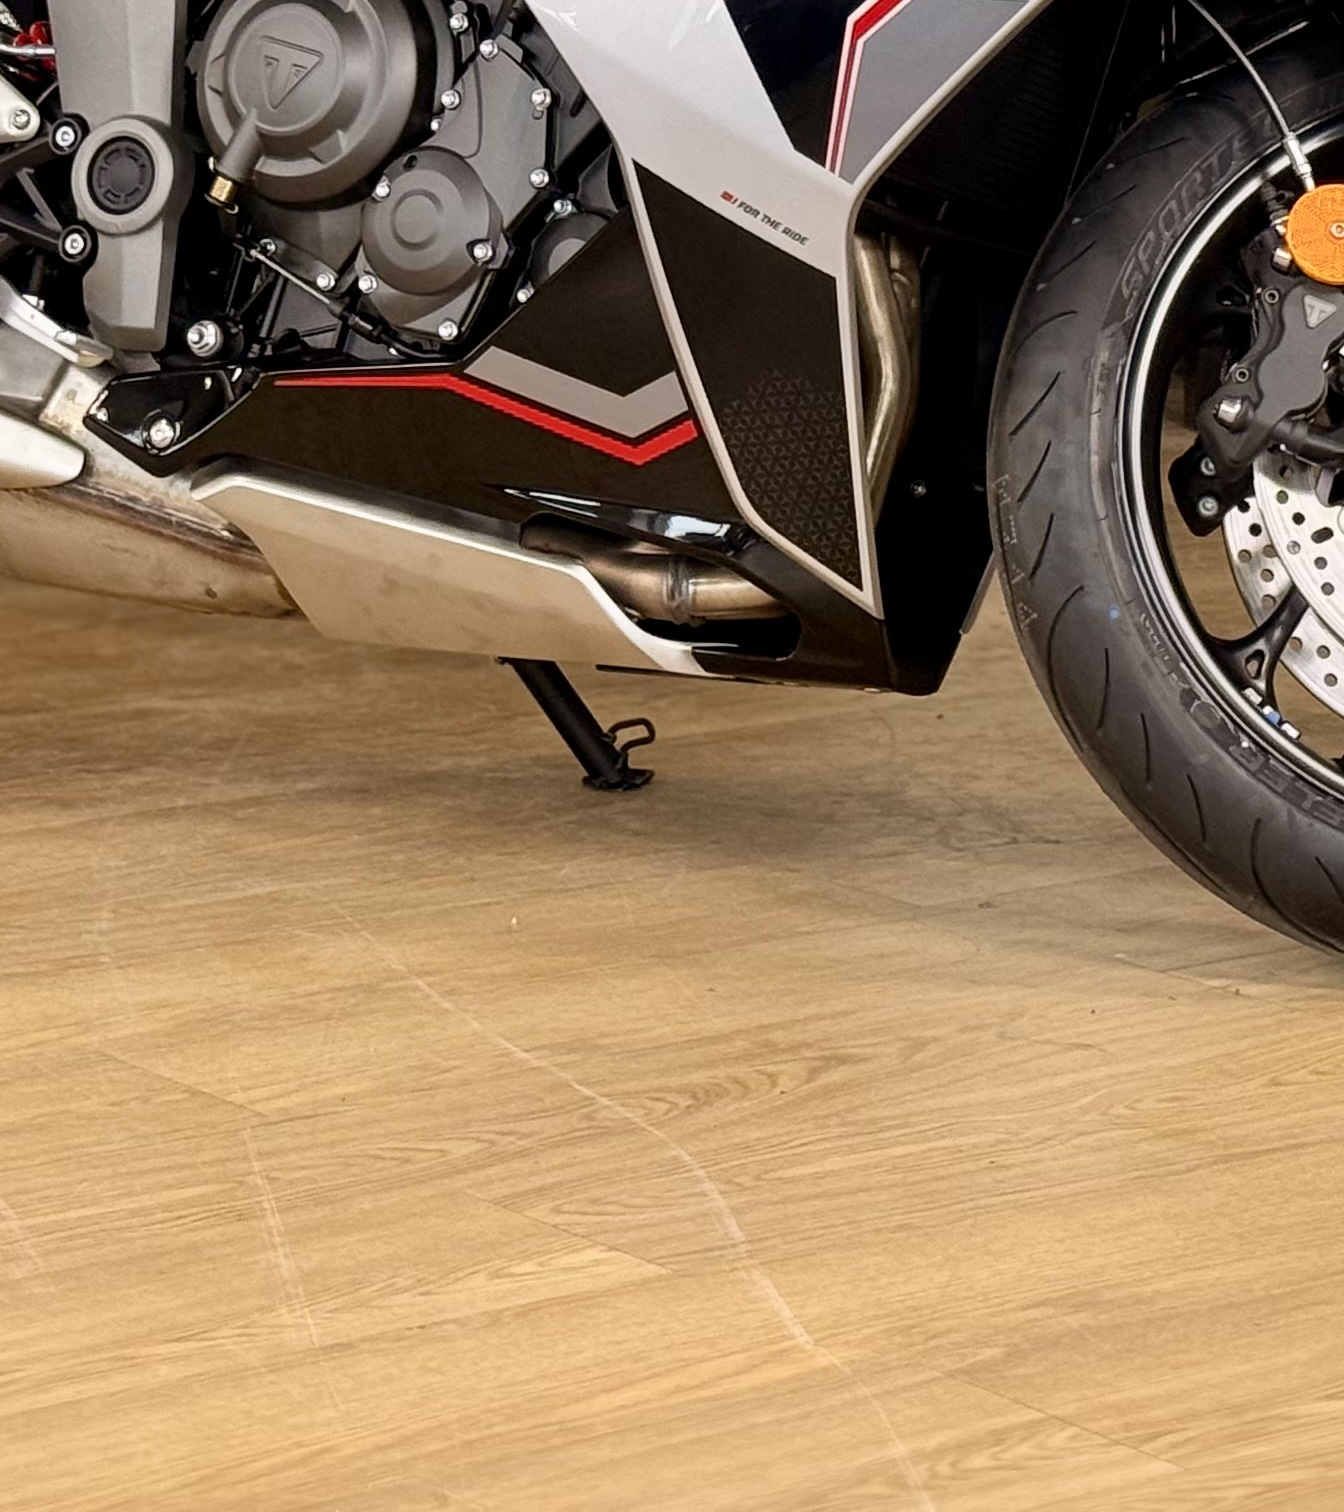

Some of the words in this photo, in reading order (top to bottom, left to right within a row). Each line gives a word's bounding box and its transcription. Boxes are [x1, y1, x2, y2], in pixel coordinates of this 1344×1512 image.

[737, 201, 760, 219] FOR
[760, 214, 783, 231] THE
[781, 226, 810, 246] RIDE
